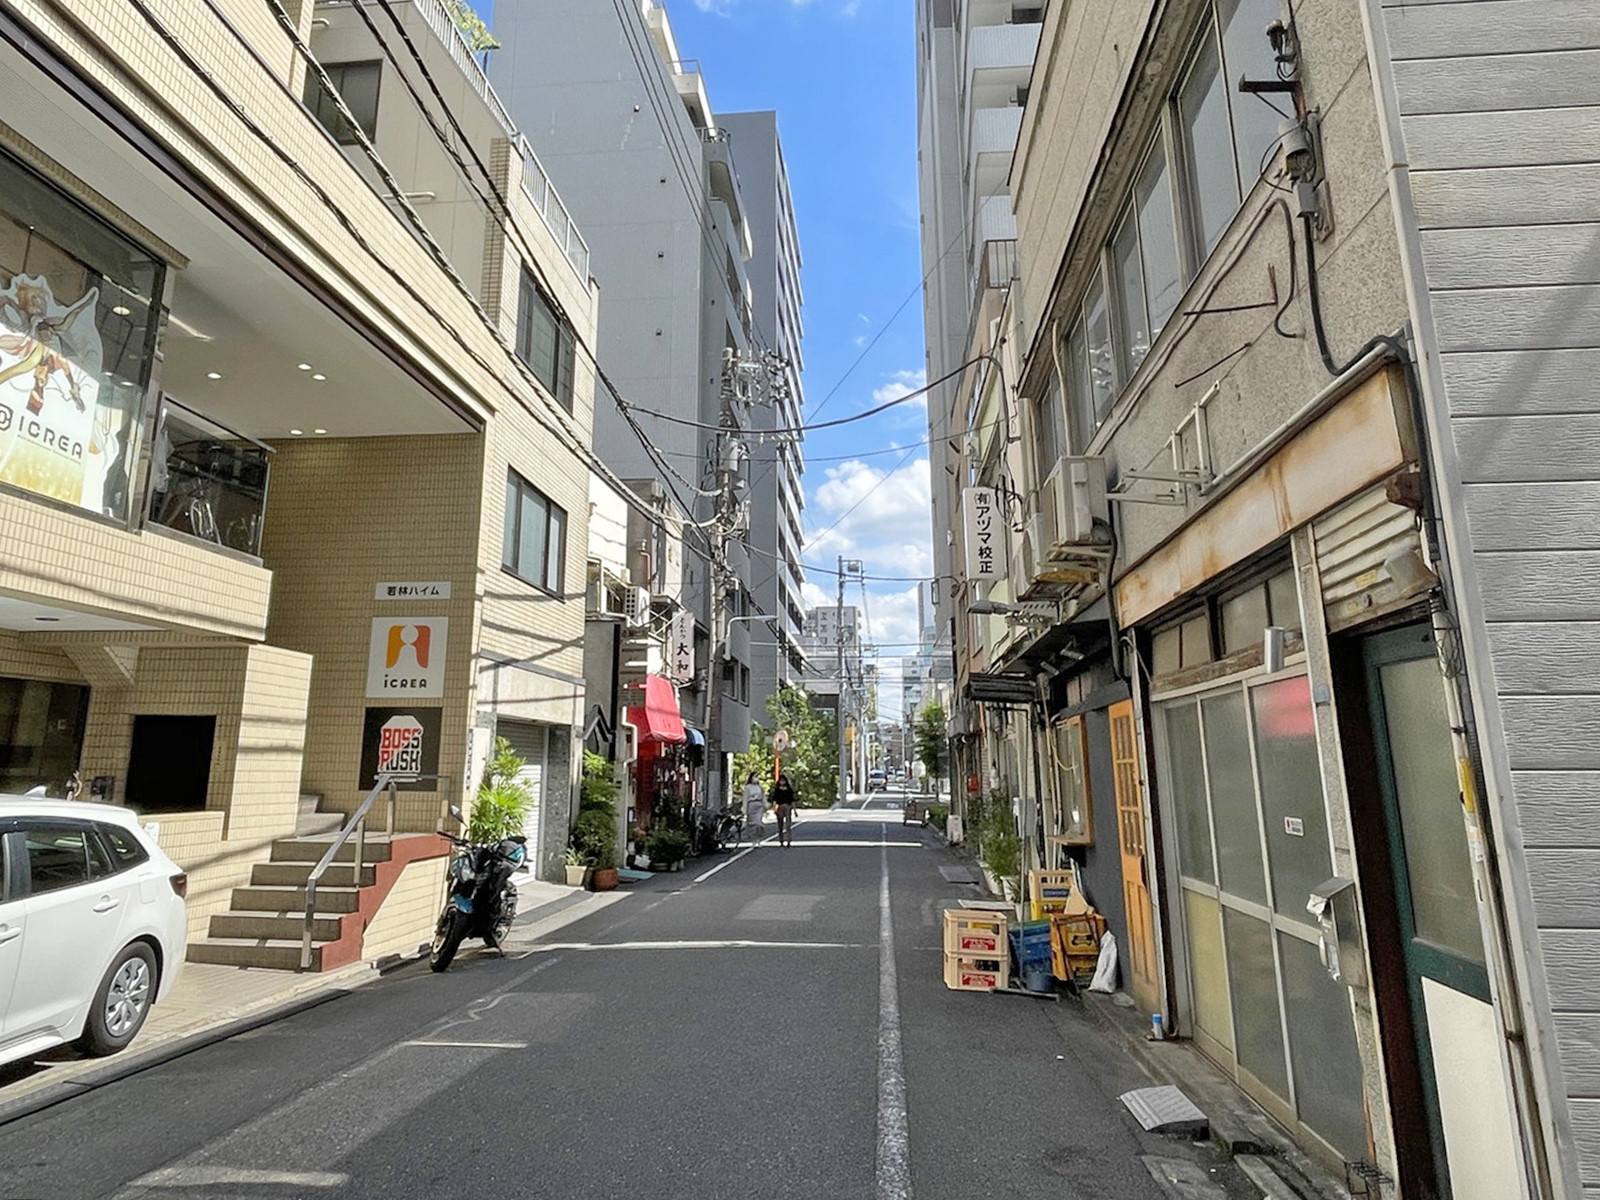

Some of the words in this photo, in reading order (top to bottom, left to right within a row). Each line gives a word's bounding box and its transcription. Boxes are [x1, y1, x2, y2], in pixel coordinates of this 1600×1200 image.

[19, 416, 83, 460] ICREA
[381, 728, 422, 750] BOSS
[379, 750, 420, 771] RUSH
